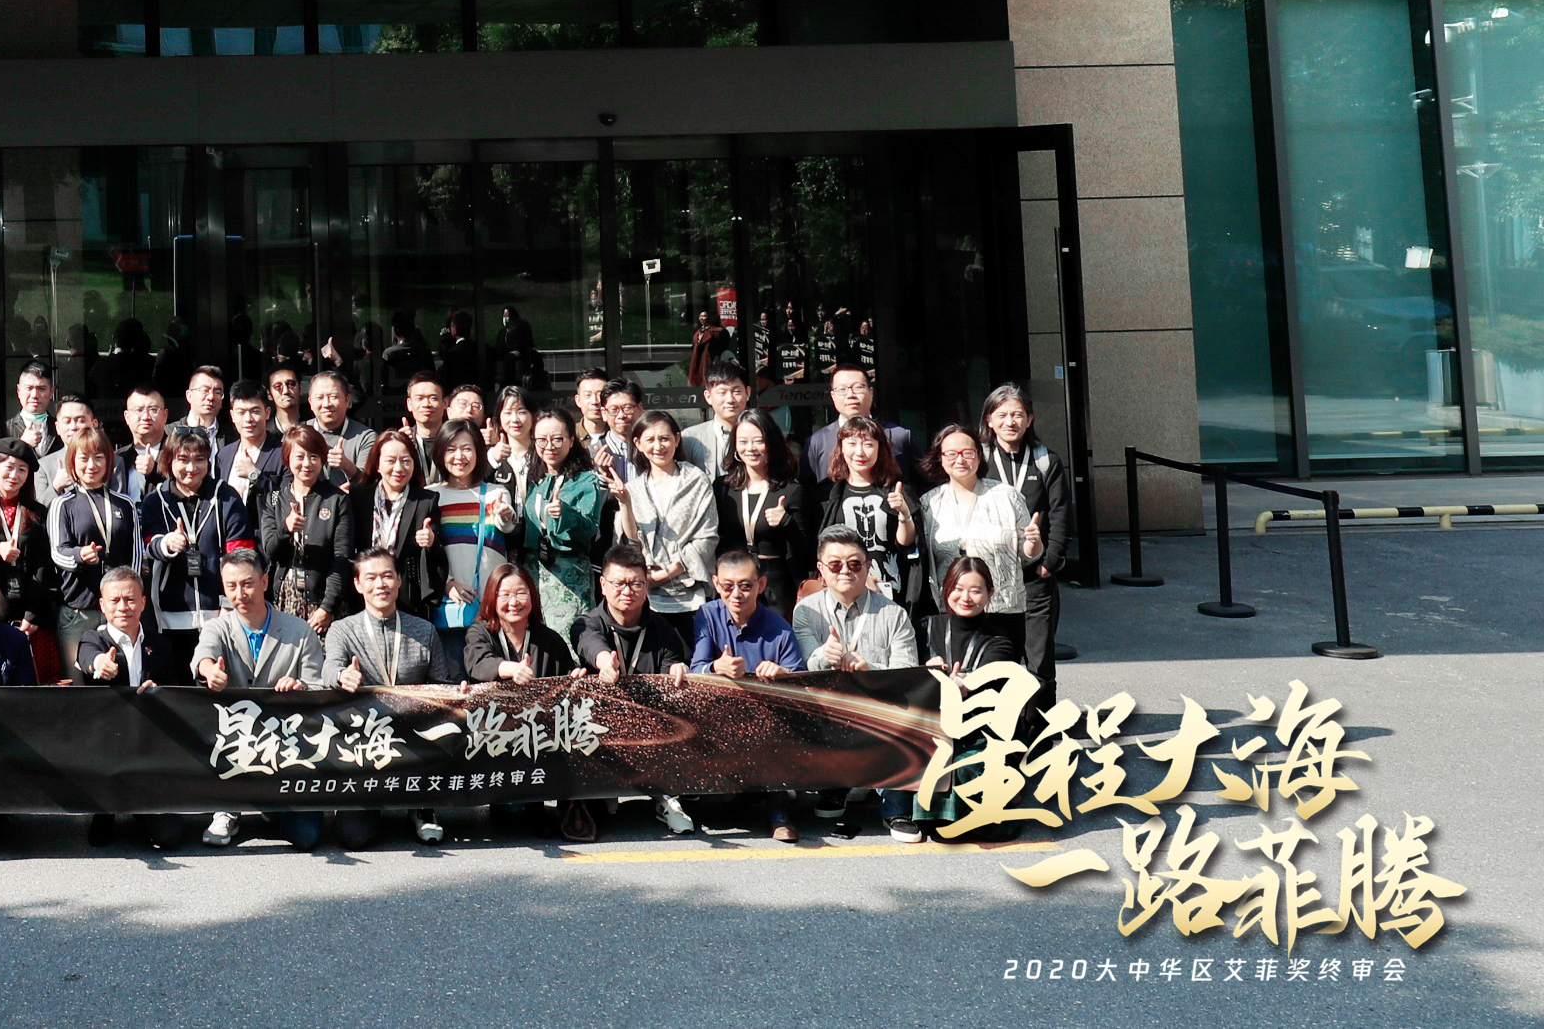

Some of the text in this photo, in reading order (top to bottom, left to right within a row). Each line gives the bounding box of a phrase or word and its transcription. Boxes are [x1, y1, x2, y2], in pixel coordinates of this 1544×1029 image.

[778, 389, 825, 401] Tence
[210, 698, 610, 780] 星程大海 一路菲腾
[278, 767, 547, 794] 2020大中华区艾菲奖终审会
